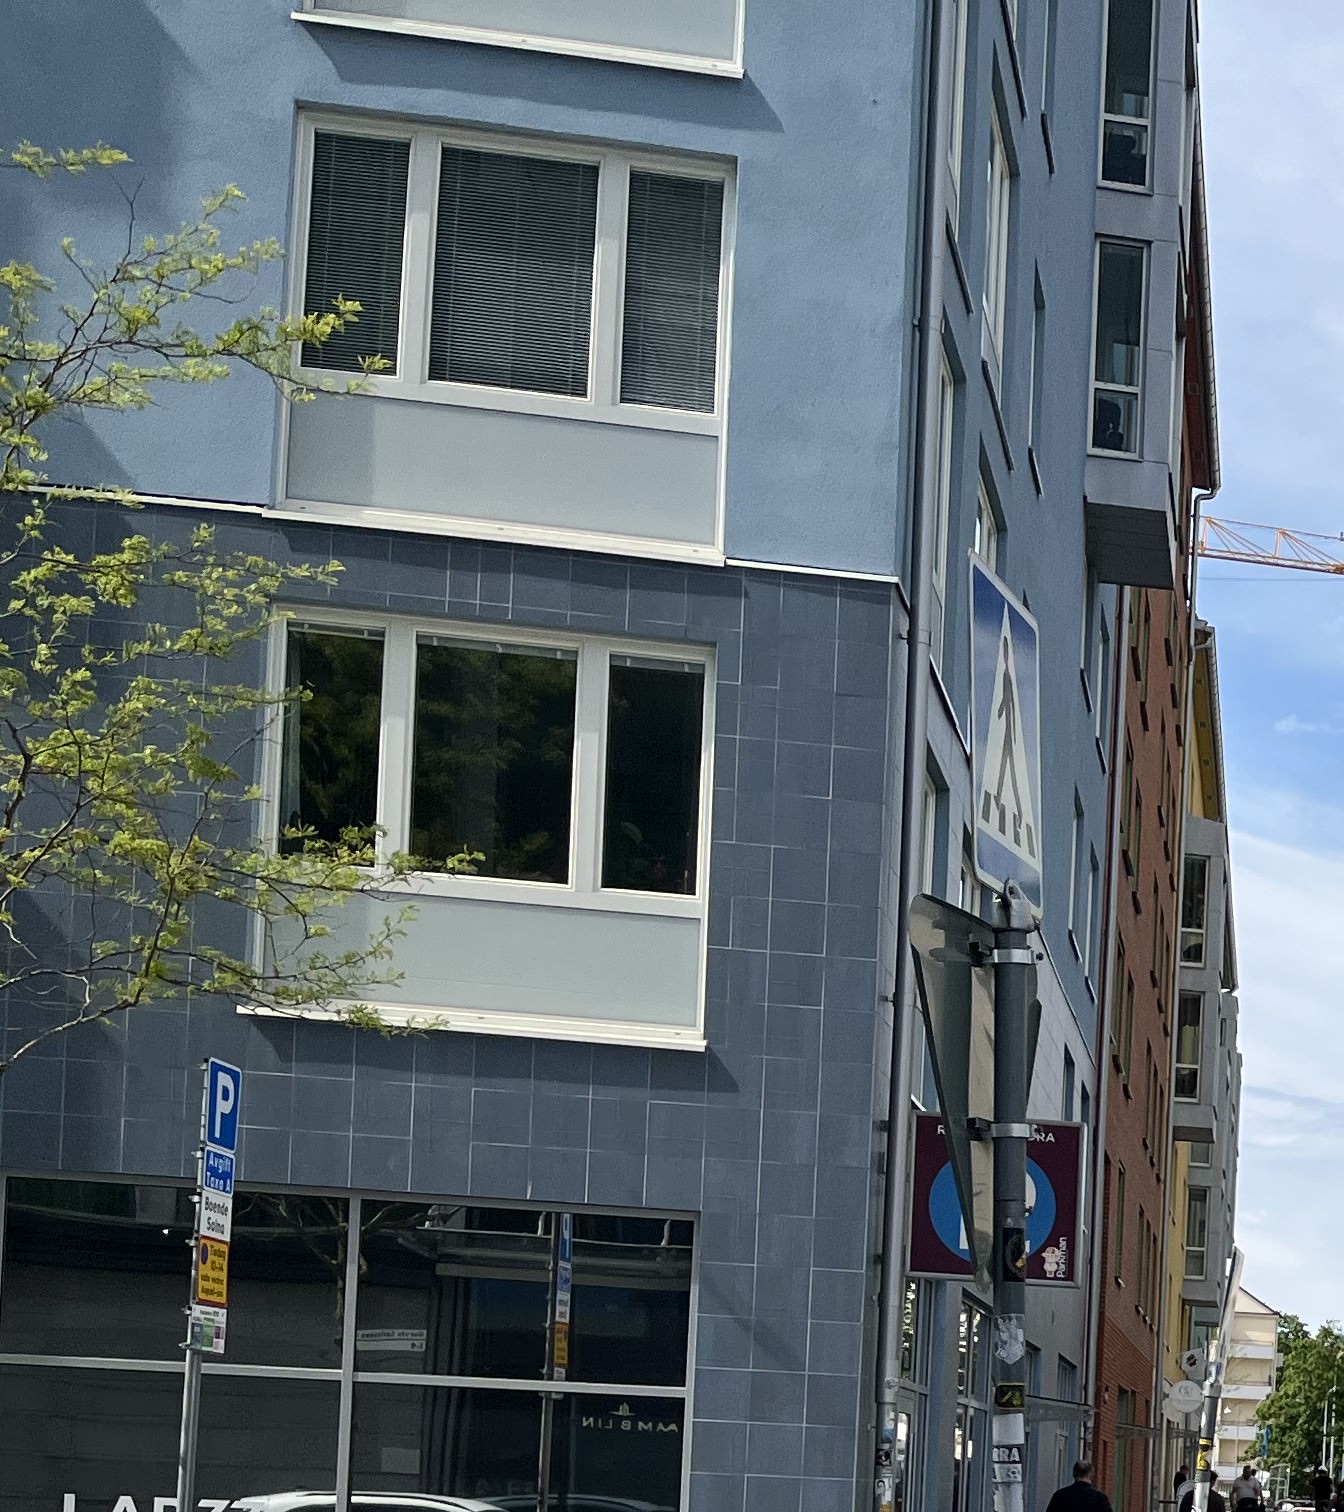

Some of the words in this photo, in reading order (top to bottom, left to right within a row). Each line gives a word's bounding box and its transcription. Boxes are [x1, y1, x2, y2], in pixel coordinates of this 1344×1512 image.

[214, 1071, 235, 1139] P
[209, 1152, 231, 1173] Avgift
[206, 1172, 224, 1191] Taxa
[225, 1180, 231, 1193] A
[204, 1196, 229, 1217] Boende
[206, 1217, 225, 1236] Solna
[1056, 1237, 1068, 1278] Parkman
